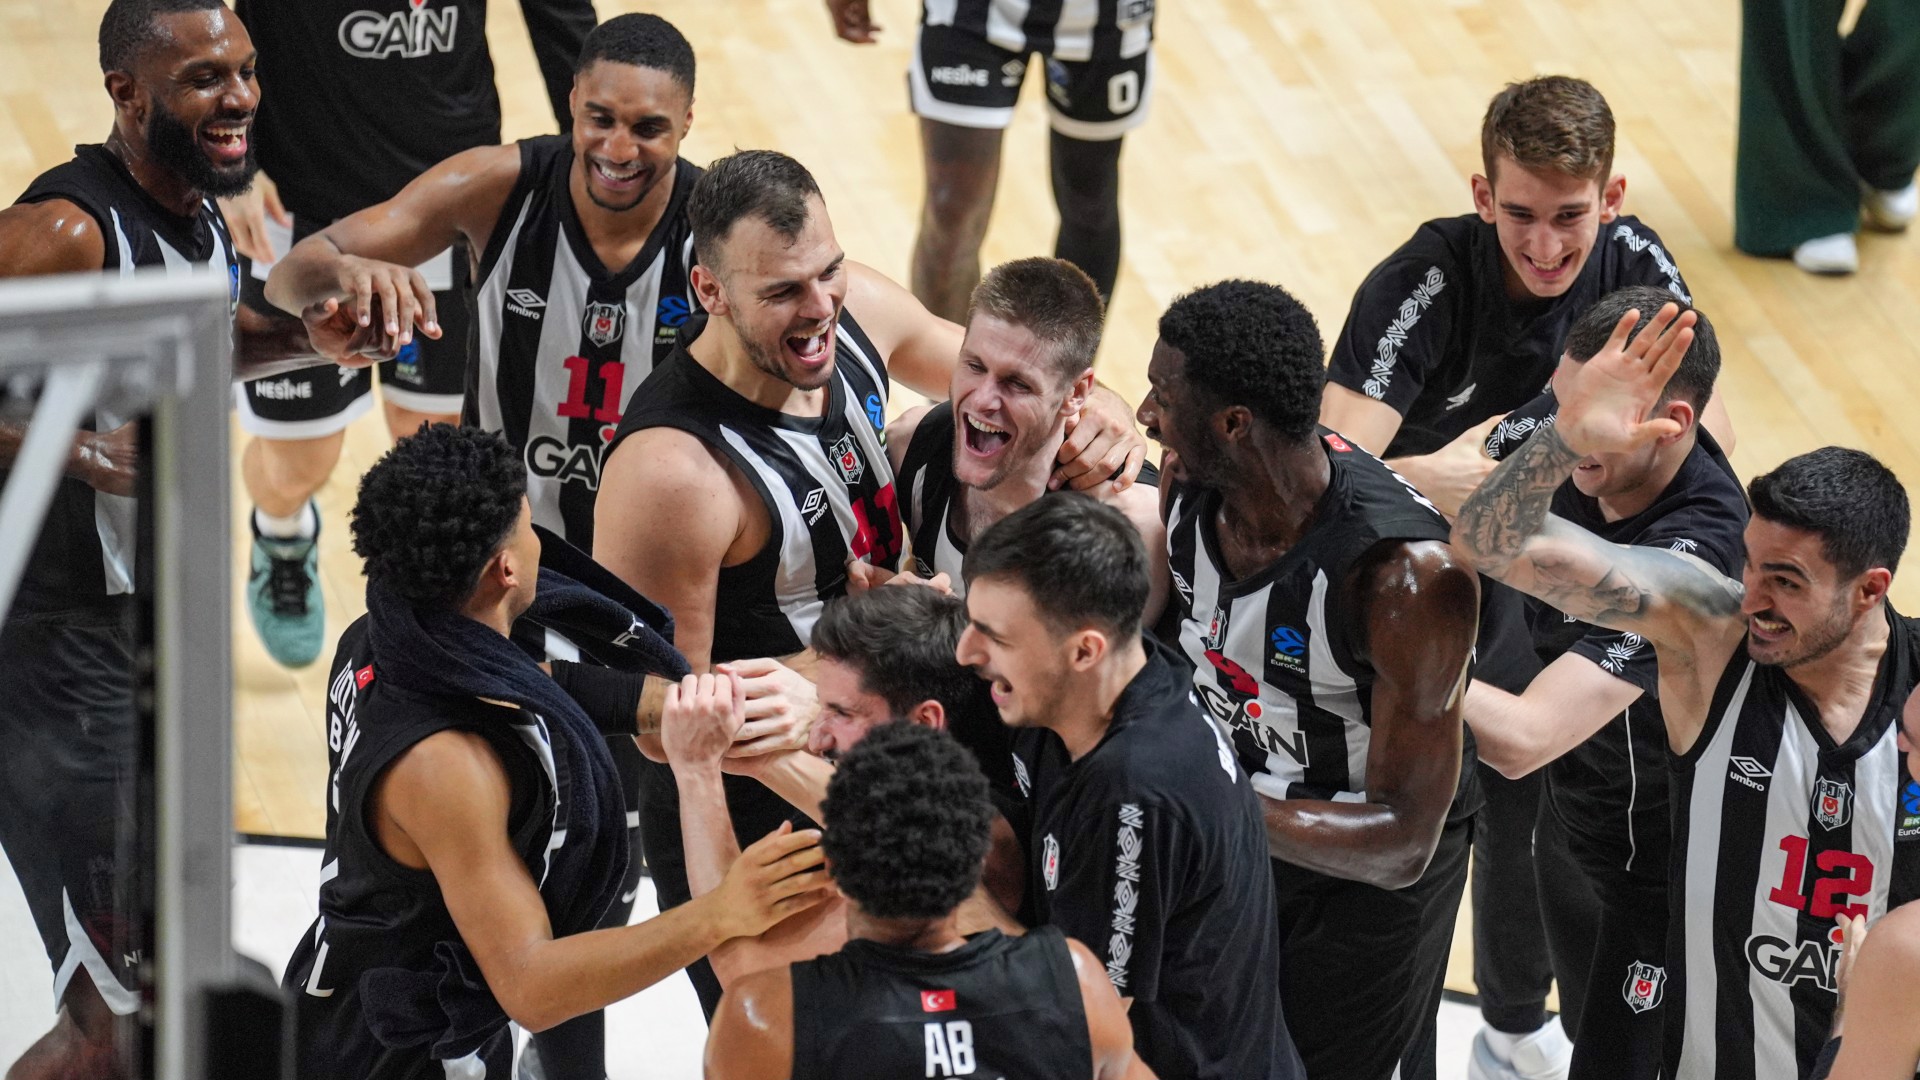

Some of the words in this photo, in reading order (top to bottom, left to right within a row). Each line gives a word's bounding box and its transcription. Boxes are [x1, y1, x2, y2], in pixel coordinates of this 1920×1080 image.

[1108, 71, 1139, 114] 0
[507, 303, 540, 320] umbro
[557, 356, 625, 424] 11
[809, 502, 828, 526] umbro
[1271, 659, 1306, 673] EuroCup
[1730, 771, 1765, 792] umbro
[1821, 782, 1844, 798] BJK
[1904, 817, 1920, 827] BK
[1769, 835, 1874, 922] 12
[1635, 966, 1660, 981] BJK
[924, 1020, 976, 1077] AB
